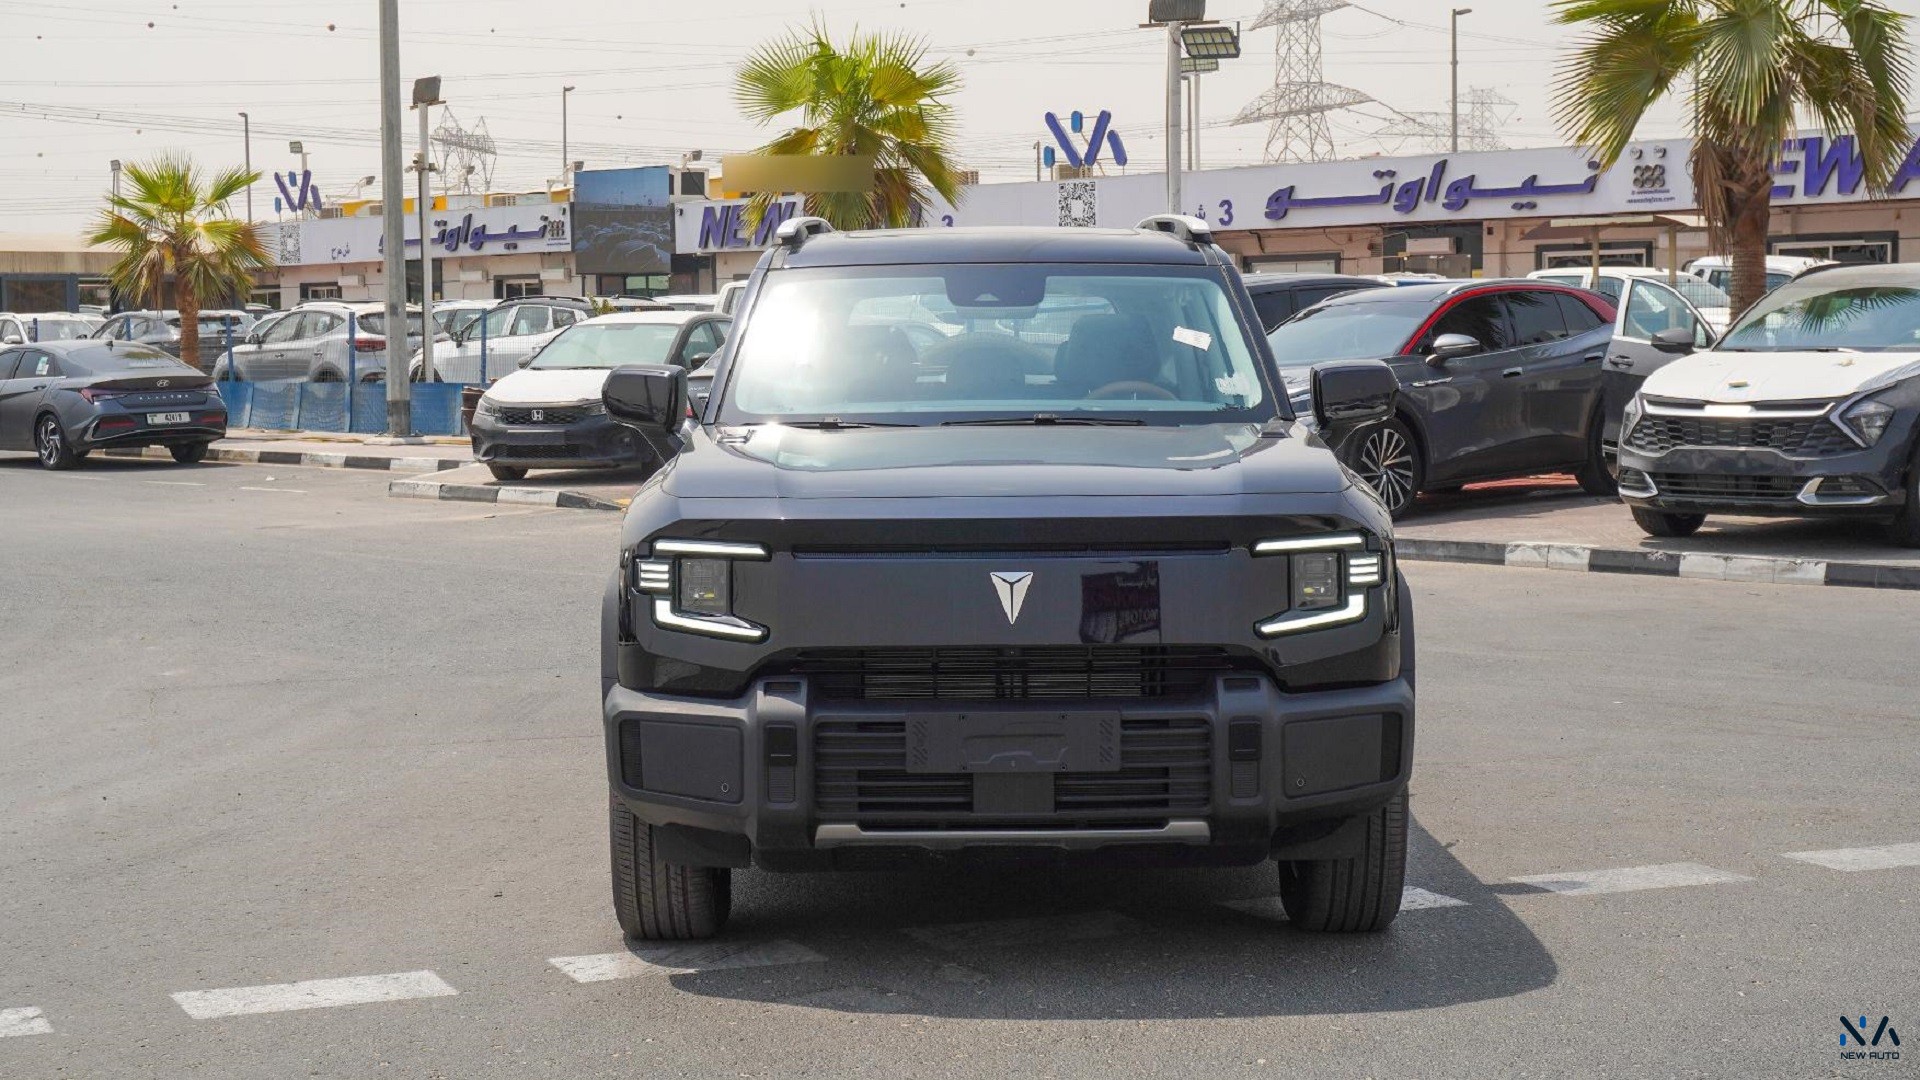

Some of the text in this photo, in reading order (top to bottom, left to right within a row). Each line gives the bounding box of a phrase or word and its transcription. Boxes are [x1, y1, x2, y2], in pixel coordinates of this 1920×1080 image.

[1767, 134, 1866, 199] EW
[697, 201, 798, 249] NEW
[1218, 199, 1234, 227] 3
